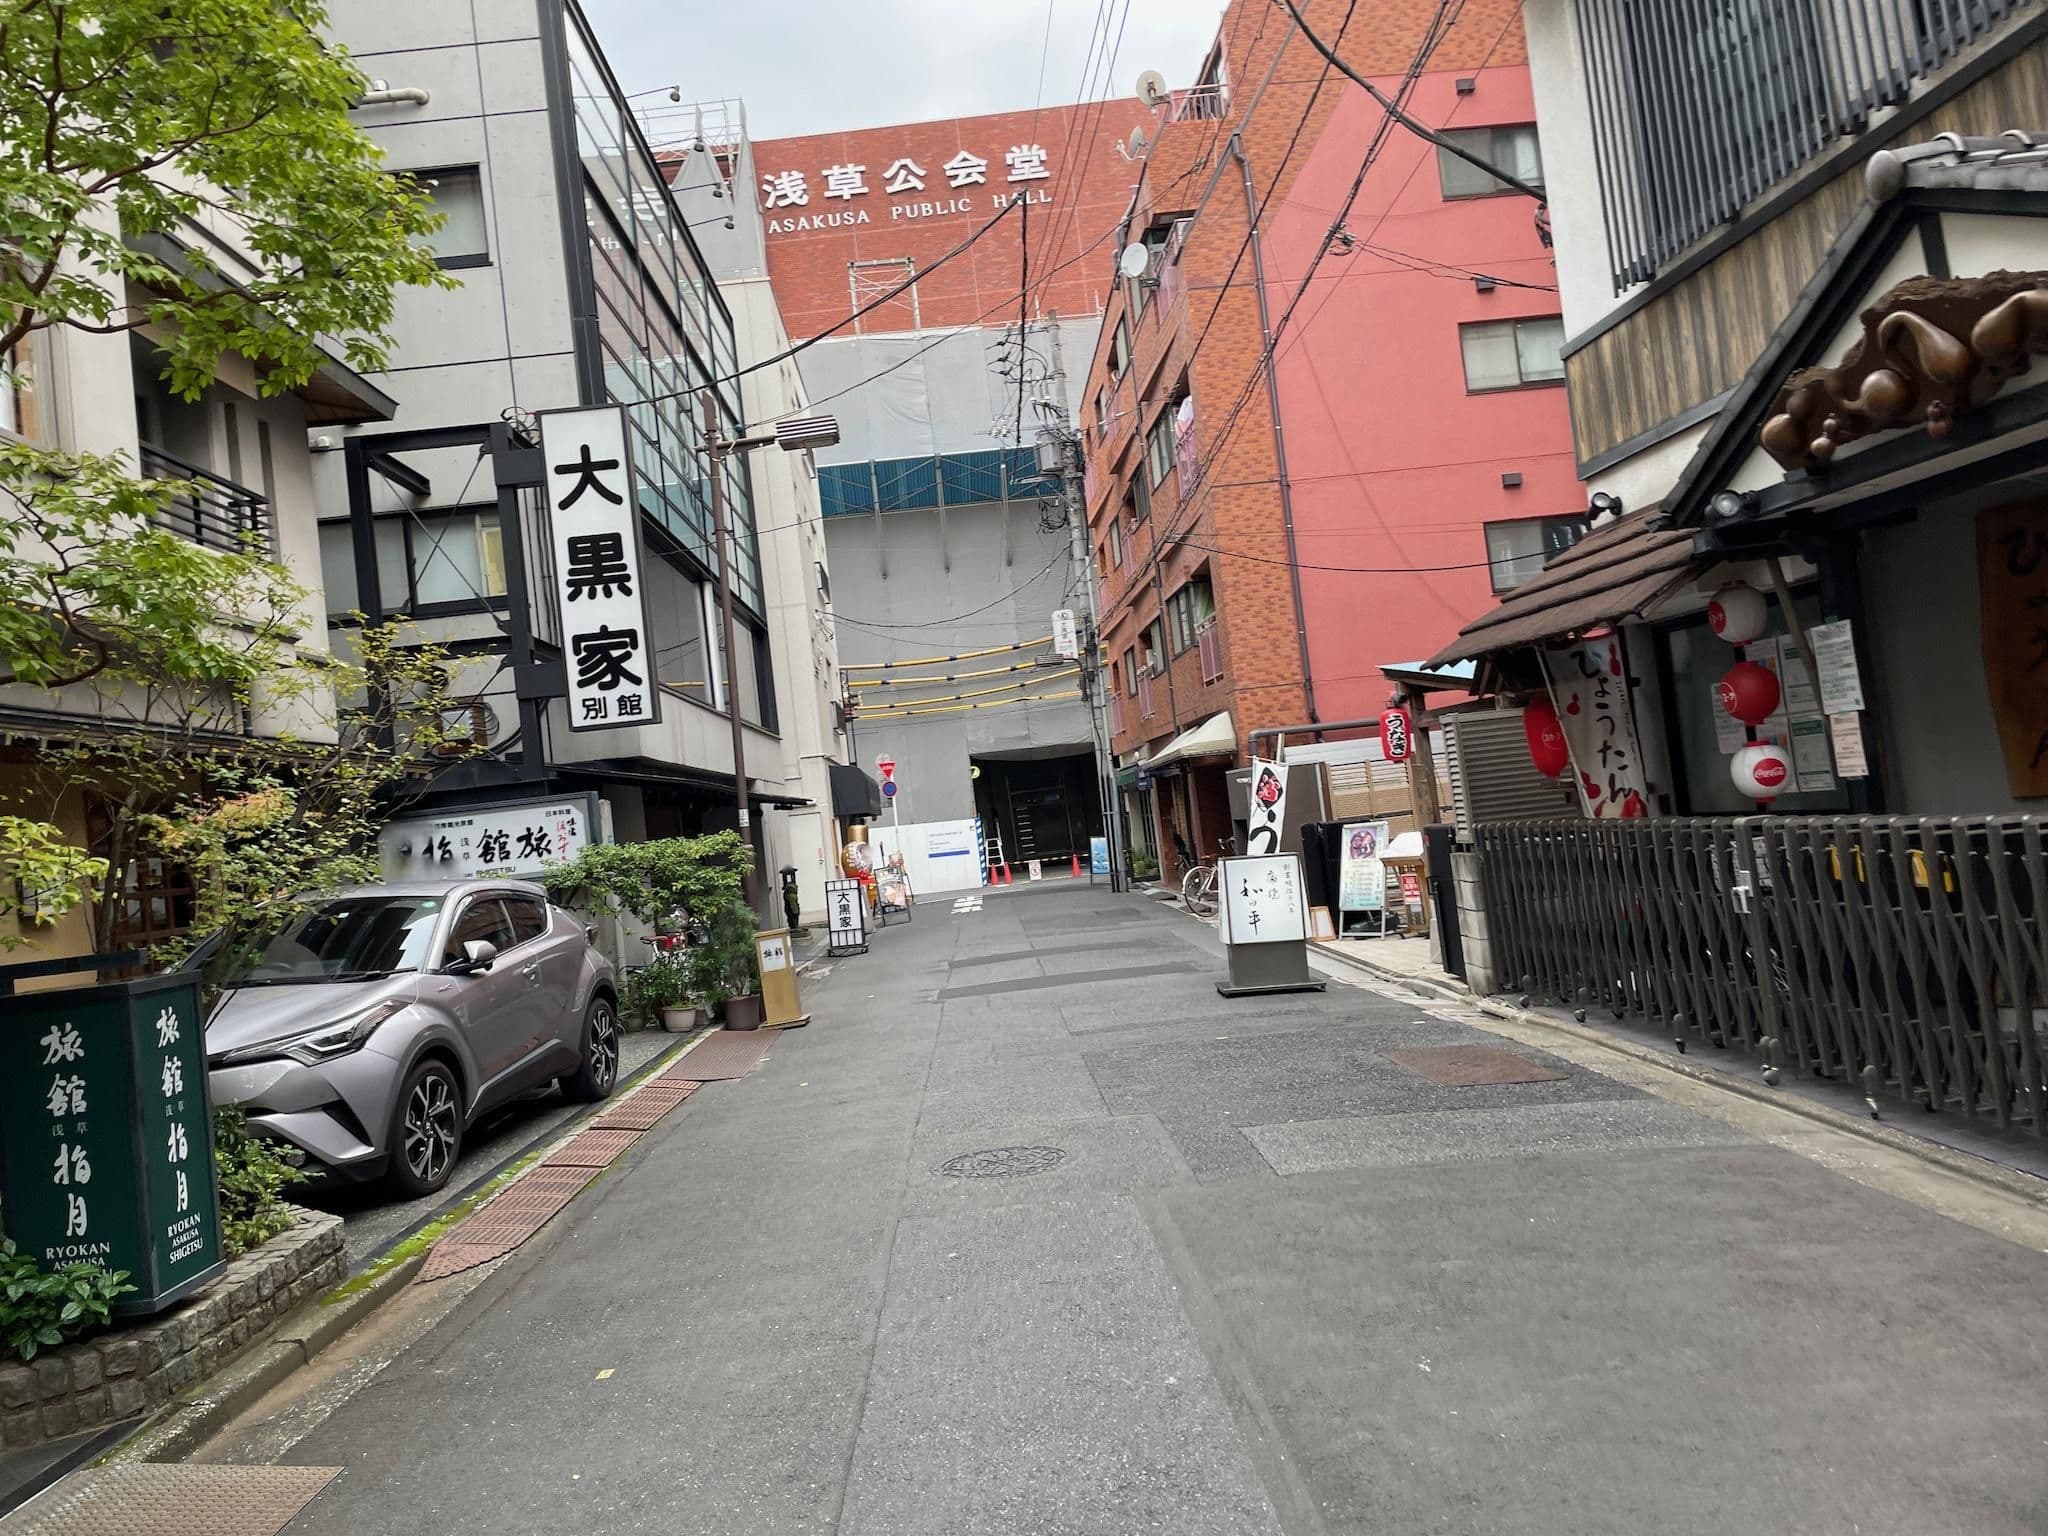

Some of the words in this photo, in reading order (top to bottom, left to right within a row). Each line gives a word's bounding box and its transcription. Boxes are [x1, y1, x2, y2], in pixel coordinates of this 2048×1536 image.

[761, 143, 1051, 210] 浅草公会堂
[768, 209, 871, 234] ASAKUSA
[891, 199, 973, 221] PUBLIC
[993, 188, 1053, 209] HALL
[553, 443, 643, 691] 大黒家
[582, 694, 643, 721] 別館
[1385, 713, 1407, 758] うなぎ
[1570, 651, 1633, 803] ひょうたん
[1753, 765, 1786, 779] Coca-Cola
[837, 892, 853, 929] 大黒家
[167, 1212, 201, 1239] RYOKAN
[172, 1228, 200, 1249] ASAKUSA
[46, 1241, 111, 1260] RYOKAN
[169, 1238, 204, 1265] SHIGETSU
